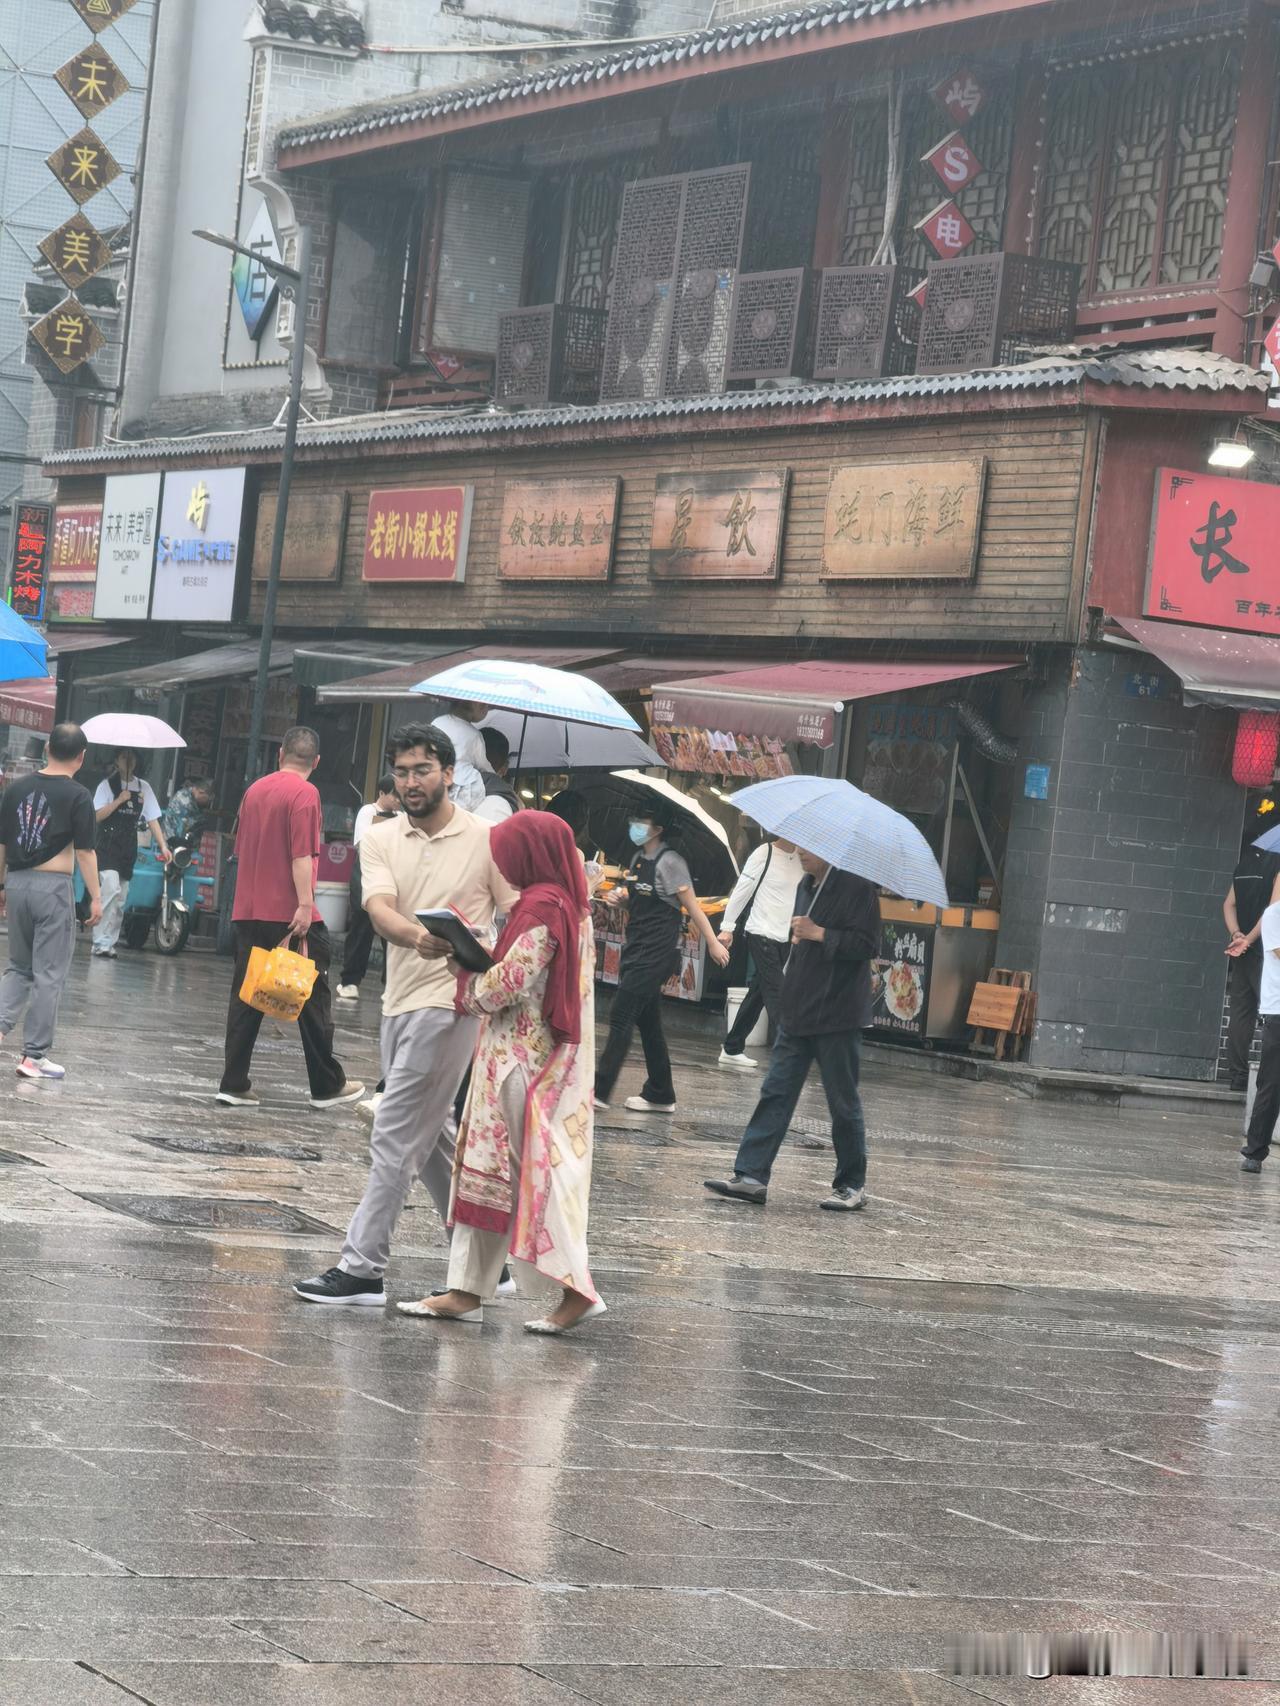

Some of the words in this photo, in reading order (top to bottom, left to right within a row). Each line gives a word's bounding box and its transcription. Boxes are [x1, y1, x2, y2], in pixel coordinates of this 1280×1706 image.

[368, 510, 458, 561] 老街小锅米线
[1189, 501, 1250, 584] 长
